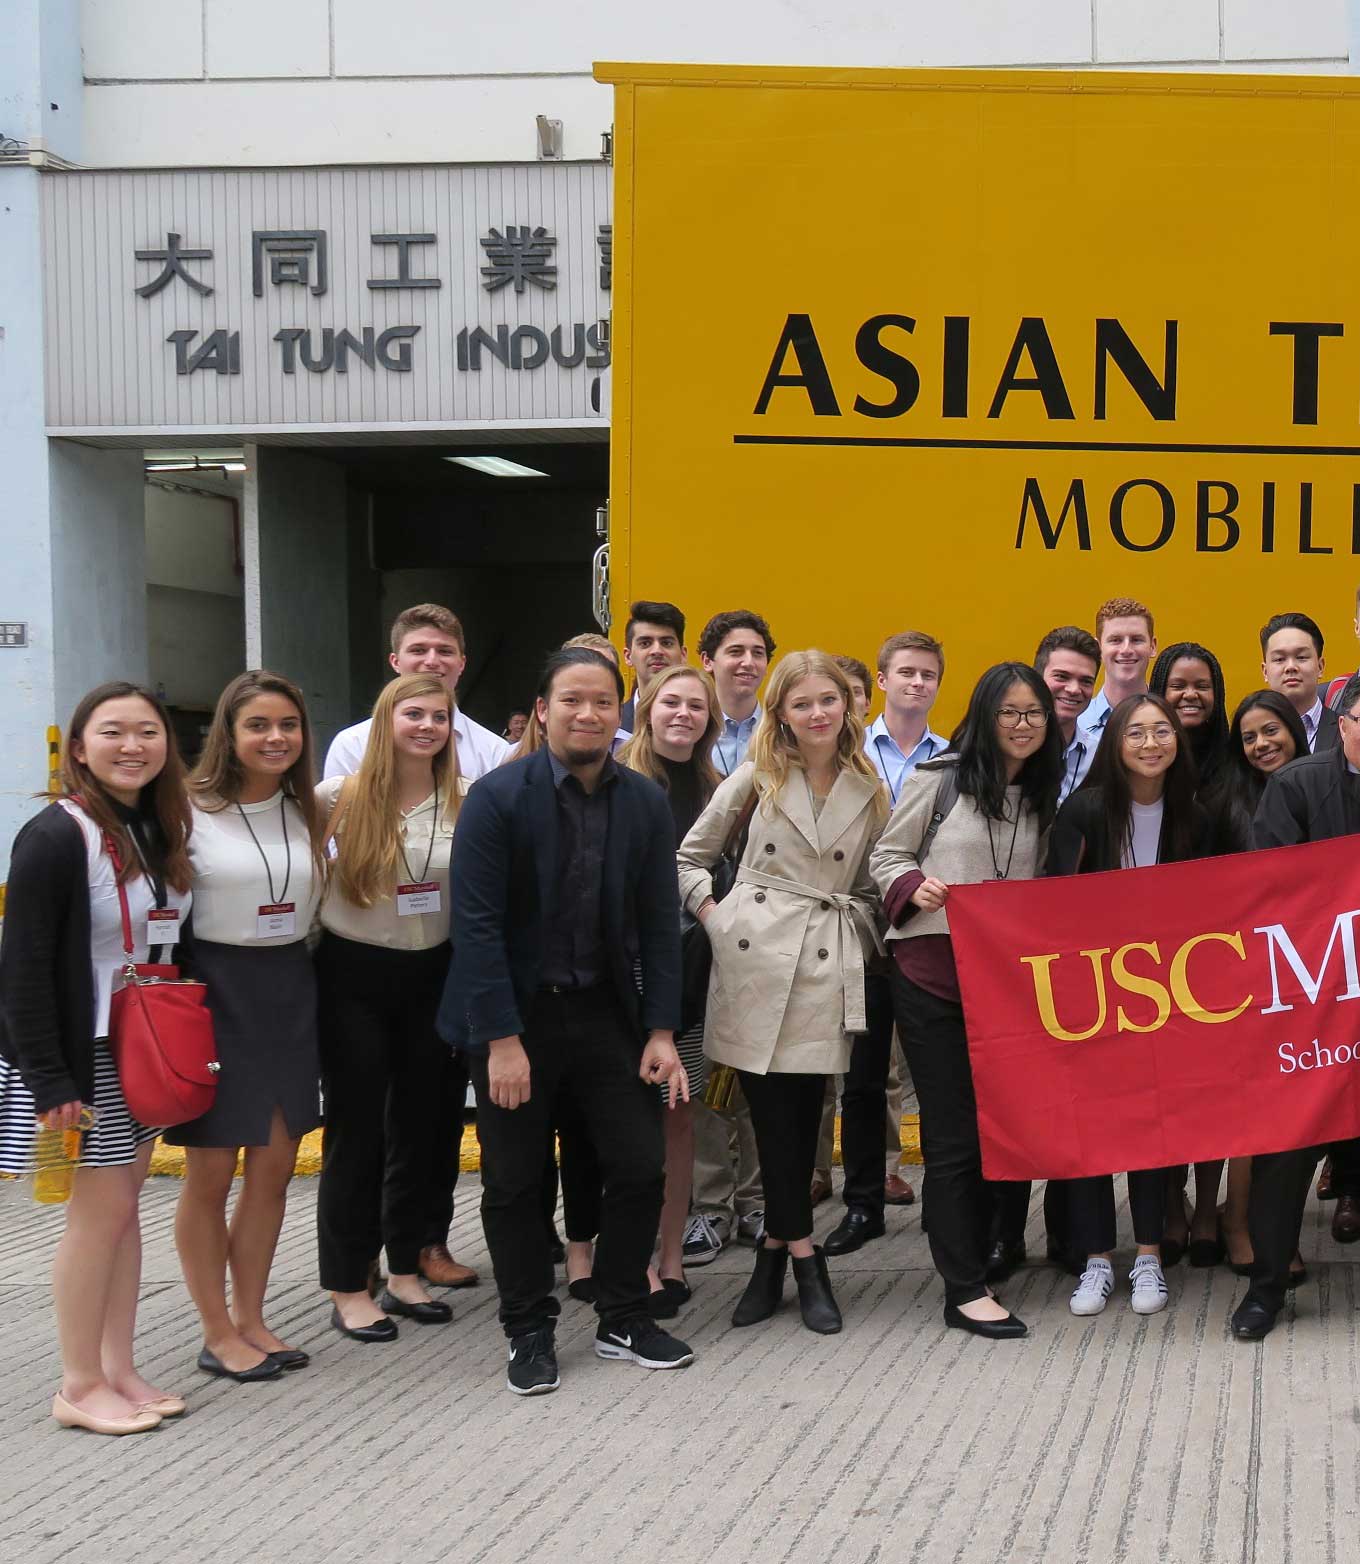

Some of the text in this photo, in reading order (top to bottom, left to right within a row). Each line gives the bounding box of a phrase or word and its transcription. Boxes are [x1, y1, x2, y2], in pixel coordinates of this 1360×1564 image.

[166, 329, 241, 376] TAI
[273, 325, 421, 374] TUNG
[753, 313, 1179, 420] ASIAN
